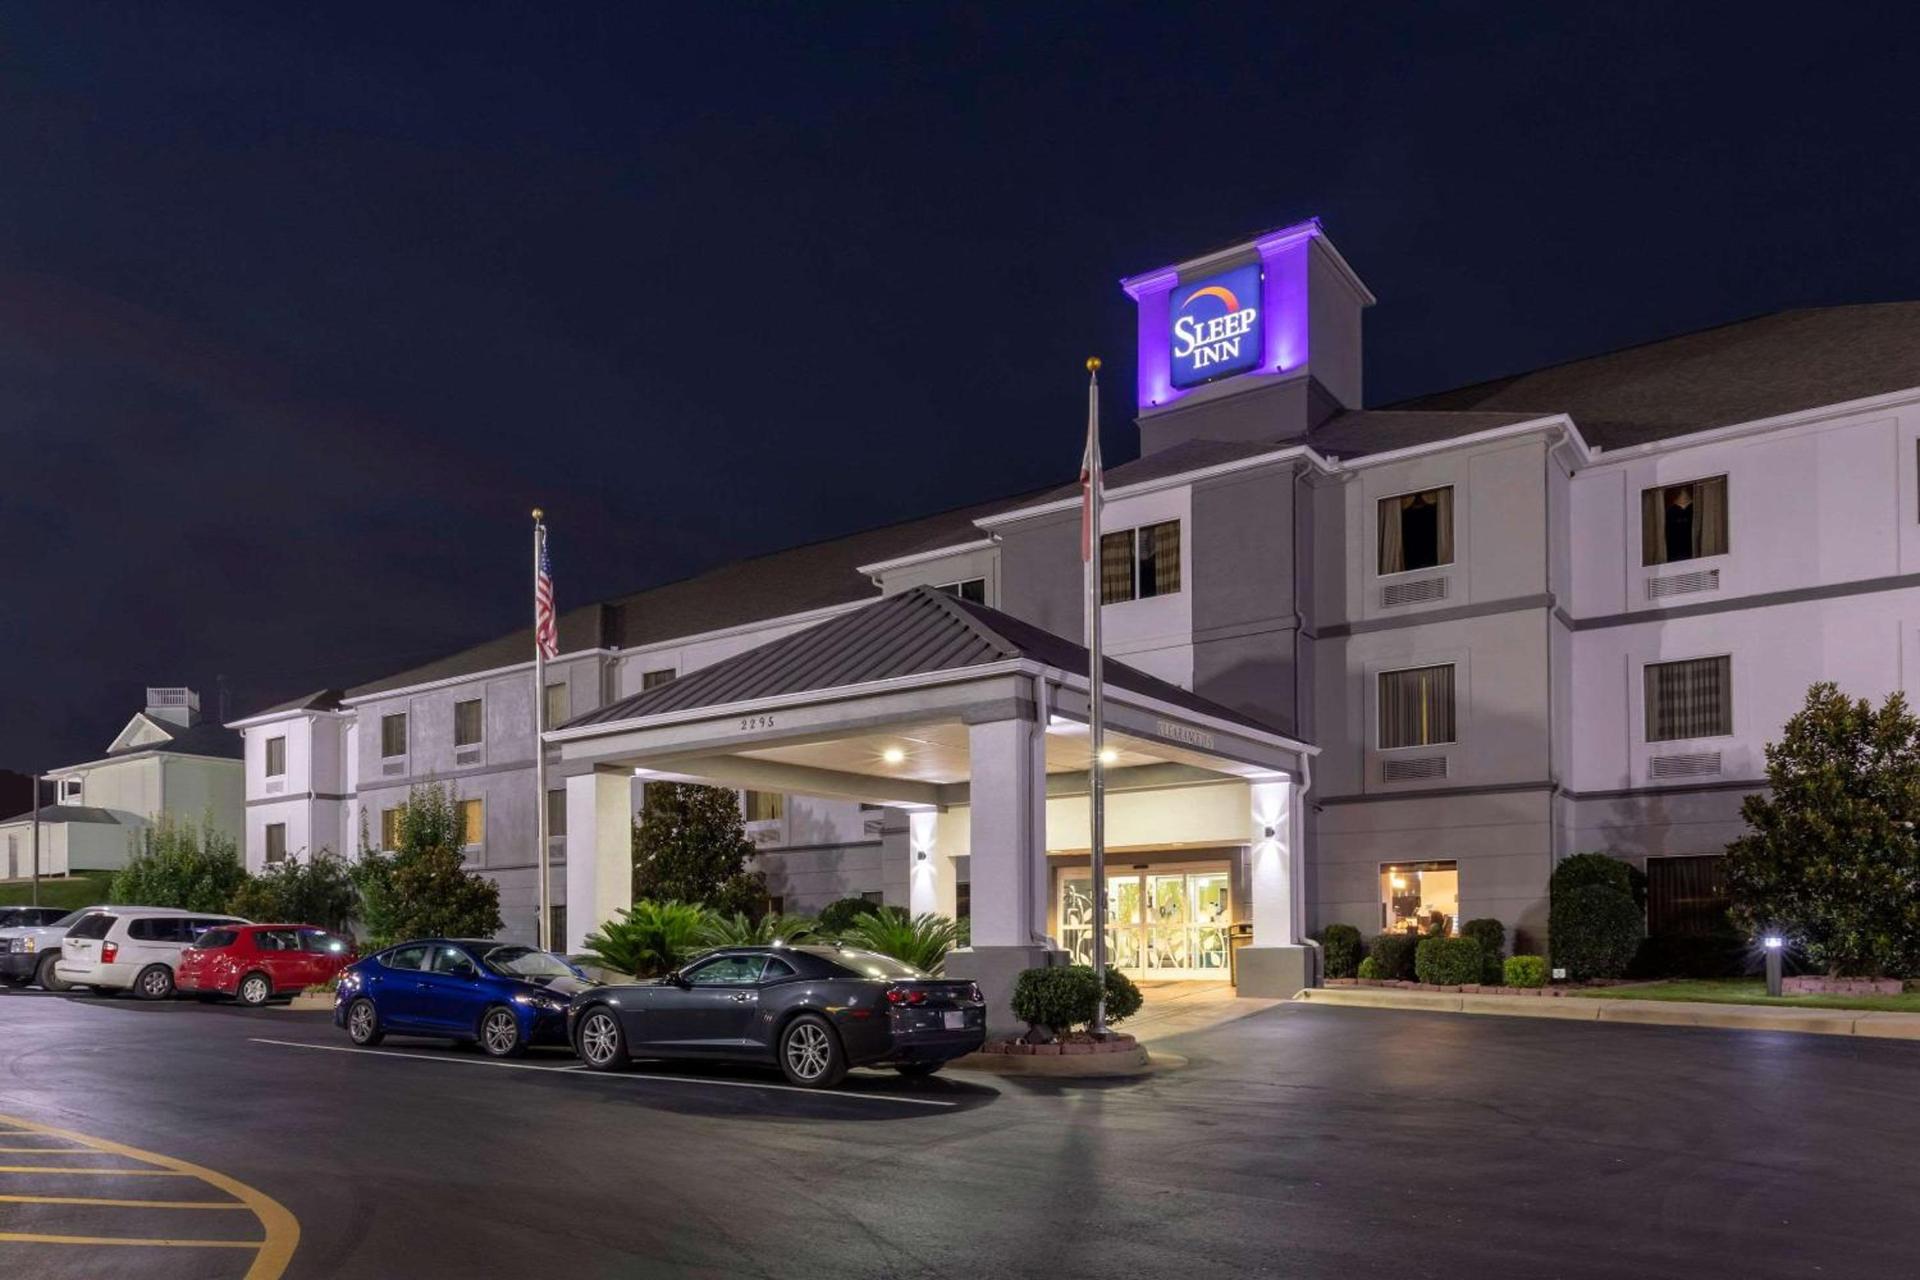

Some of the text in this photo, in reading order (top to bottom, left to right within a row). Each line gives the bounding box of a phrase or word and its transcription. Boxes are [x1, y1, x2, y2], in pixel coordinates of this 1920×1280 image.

[1174, 308, 1256, 358] SLEEP
[1193, 337, 1241, 369] INN
[741, 716, 774, 730] 2295
